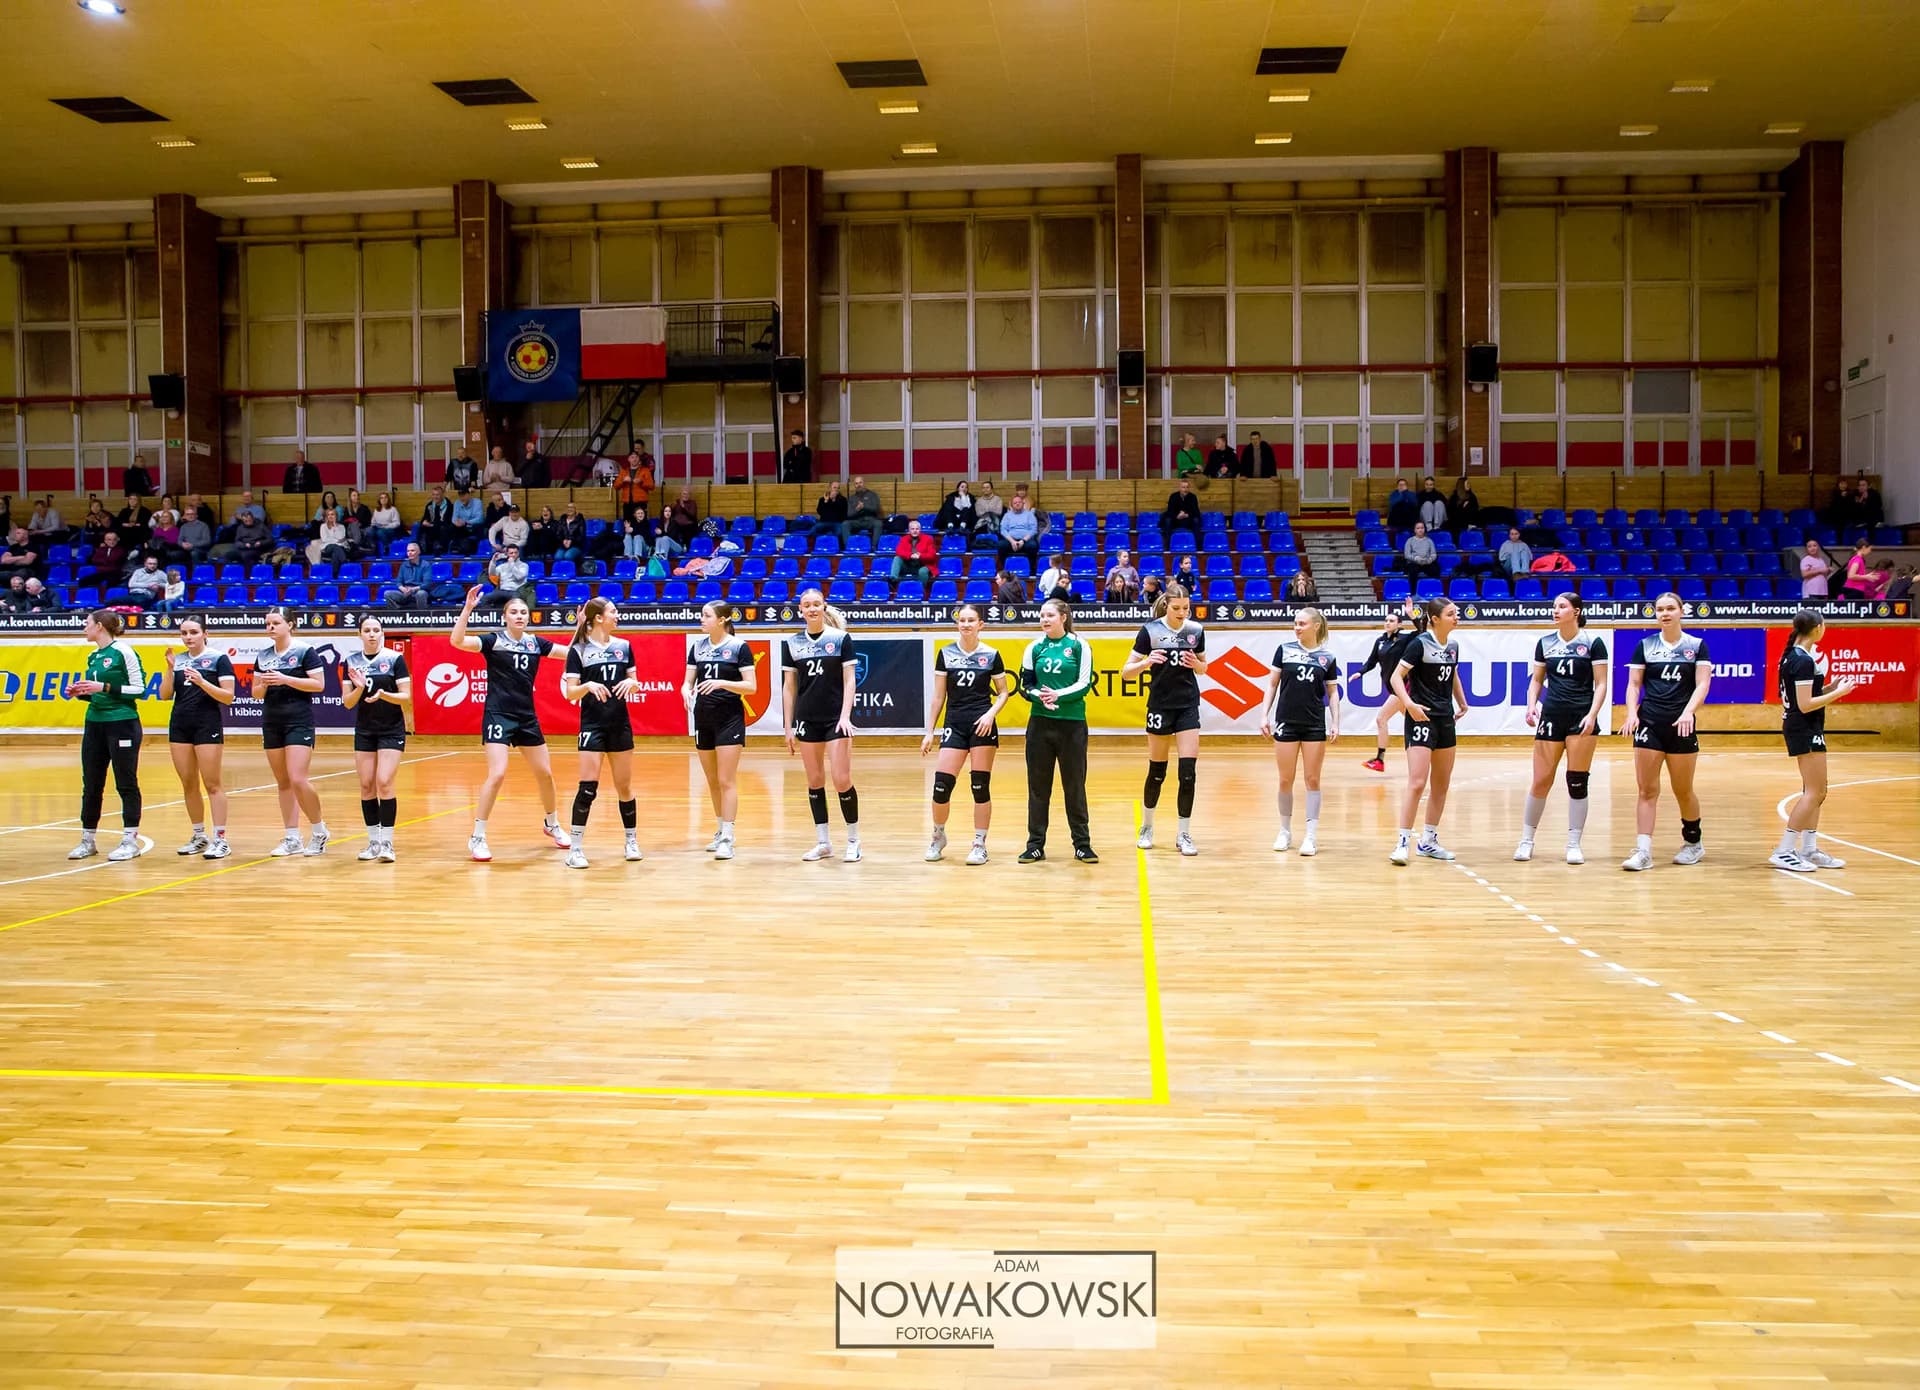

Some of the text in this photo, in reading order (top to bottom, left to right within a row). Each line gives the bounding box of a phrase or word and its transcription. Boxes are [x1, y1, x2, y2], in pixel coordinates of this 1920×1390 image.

[512, 653, 529, 670] 13
[1831, 649, 1860, 660] LIGA
[600, 664, 617, 681] 17
[704, 663, 719, 679] 21
[806, 659, 824, 676] 24
[1043, 657, 1062, 674] 32
[1296, 665, 1315, 682] 34
[1437, 665, 1452, 682] 39
[1556, 659, 1574, 675] 41
[1660, 664, 1682, 681] 44
[1831, 661, 1905, 673] CENTRALNA
[470, 669, 488, 680] LIG
[956, 671, 976, 687] 29
[637, 681, 674, 692] RALNA
[852, 692, 894, 707] FIKA
[235, 707, 263, 717] kibico
[1147, 713, 1162, 729] 33
[487, 724, 503, 739] 13
[1412, 725, 1430, 742] 39
